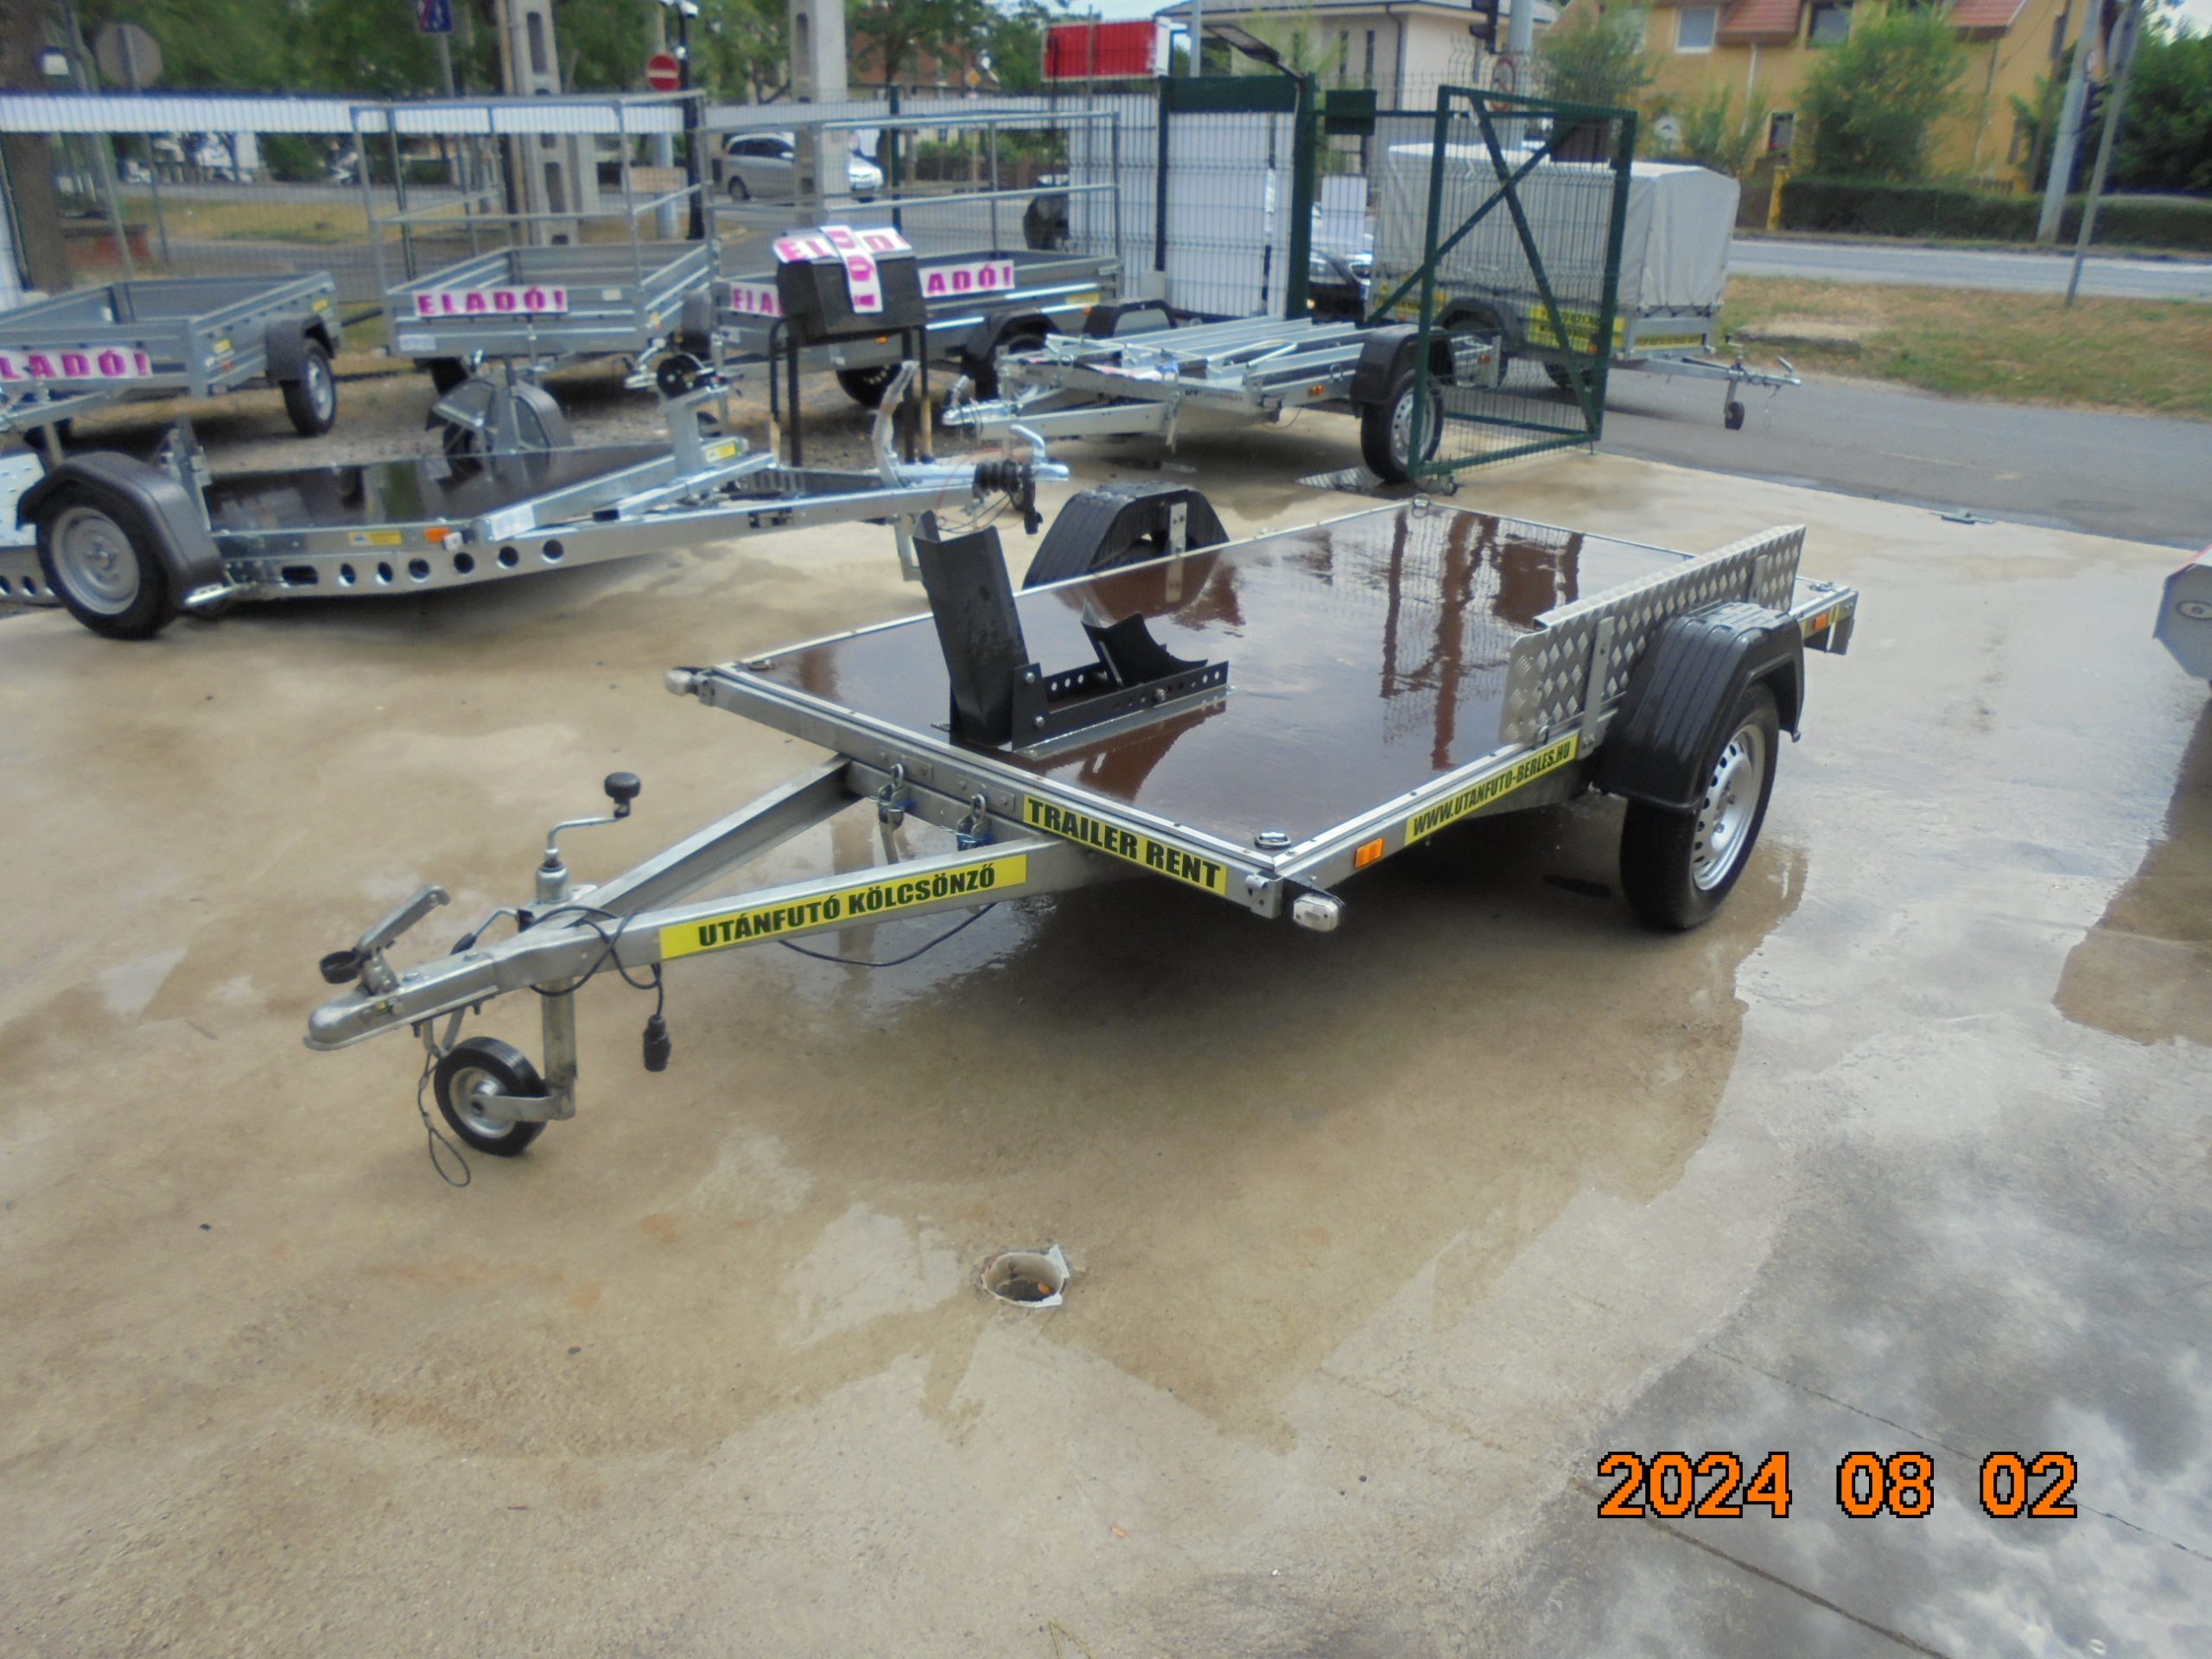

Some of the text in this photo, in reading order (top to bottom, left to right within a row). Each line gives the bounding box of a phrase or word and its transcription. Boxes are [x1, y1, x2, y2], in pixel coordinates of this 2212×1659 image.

[418, 286, 564, 314] ELADÓ!
[1414, 741, 1571, 836] WWW.UTANFUTO-BERLES.HU
[1028, 798, 1220, 888] TRAILER RENT
[698, 863, 995, 947] UTÁNFUTÓ KÖLCSÖNZŐ
